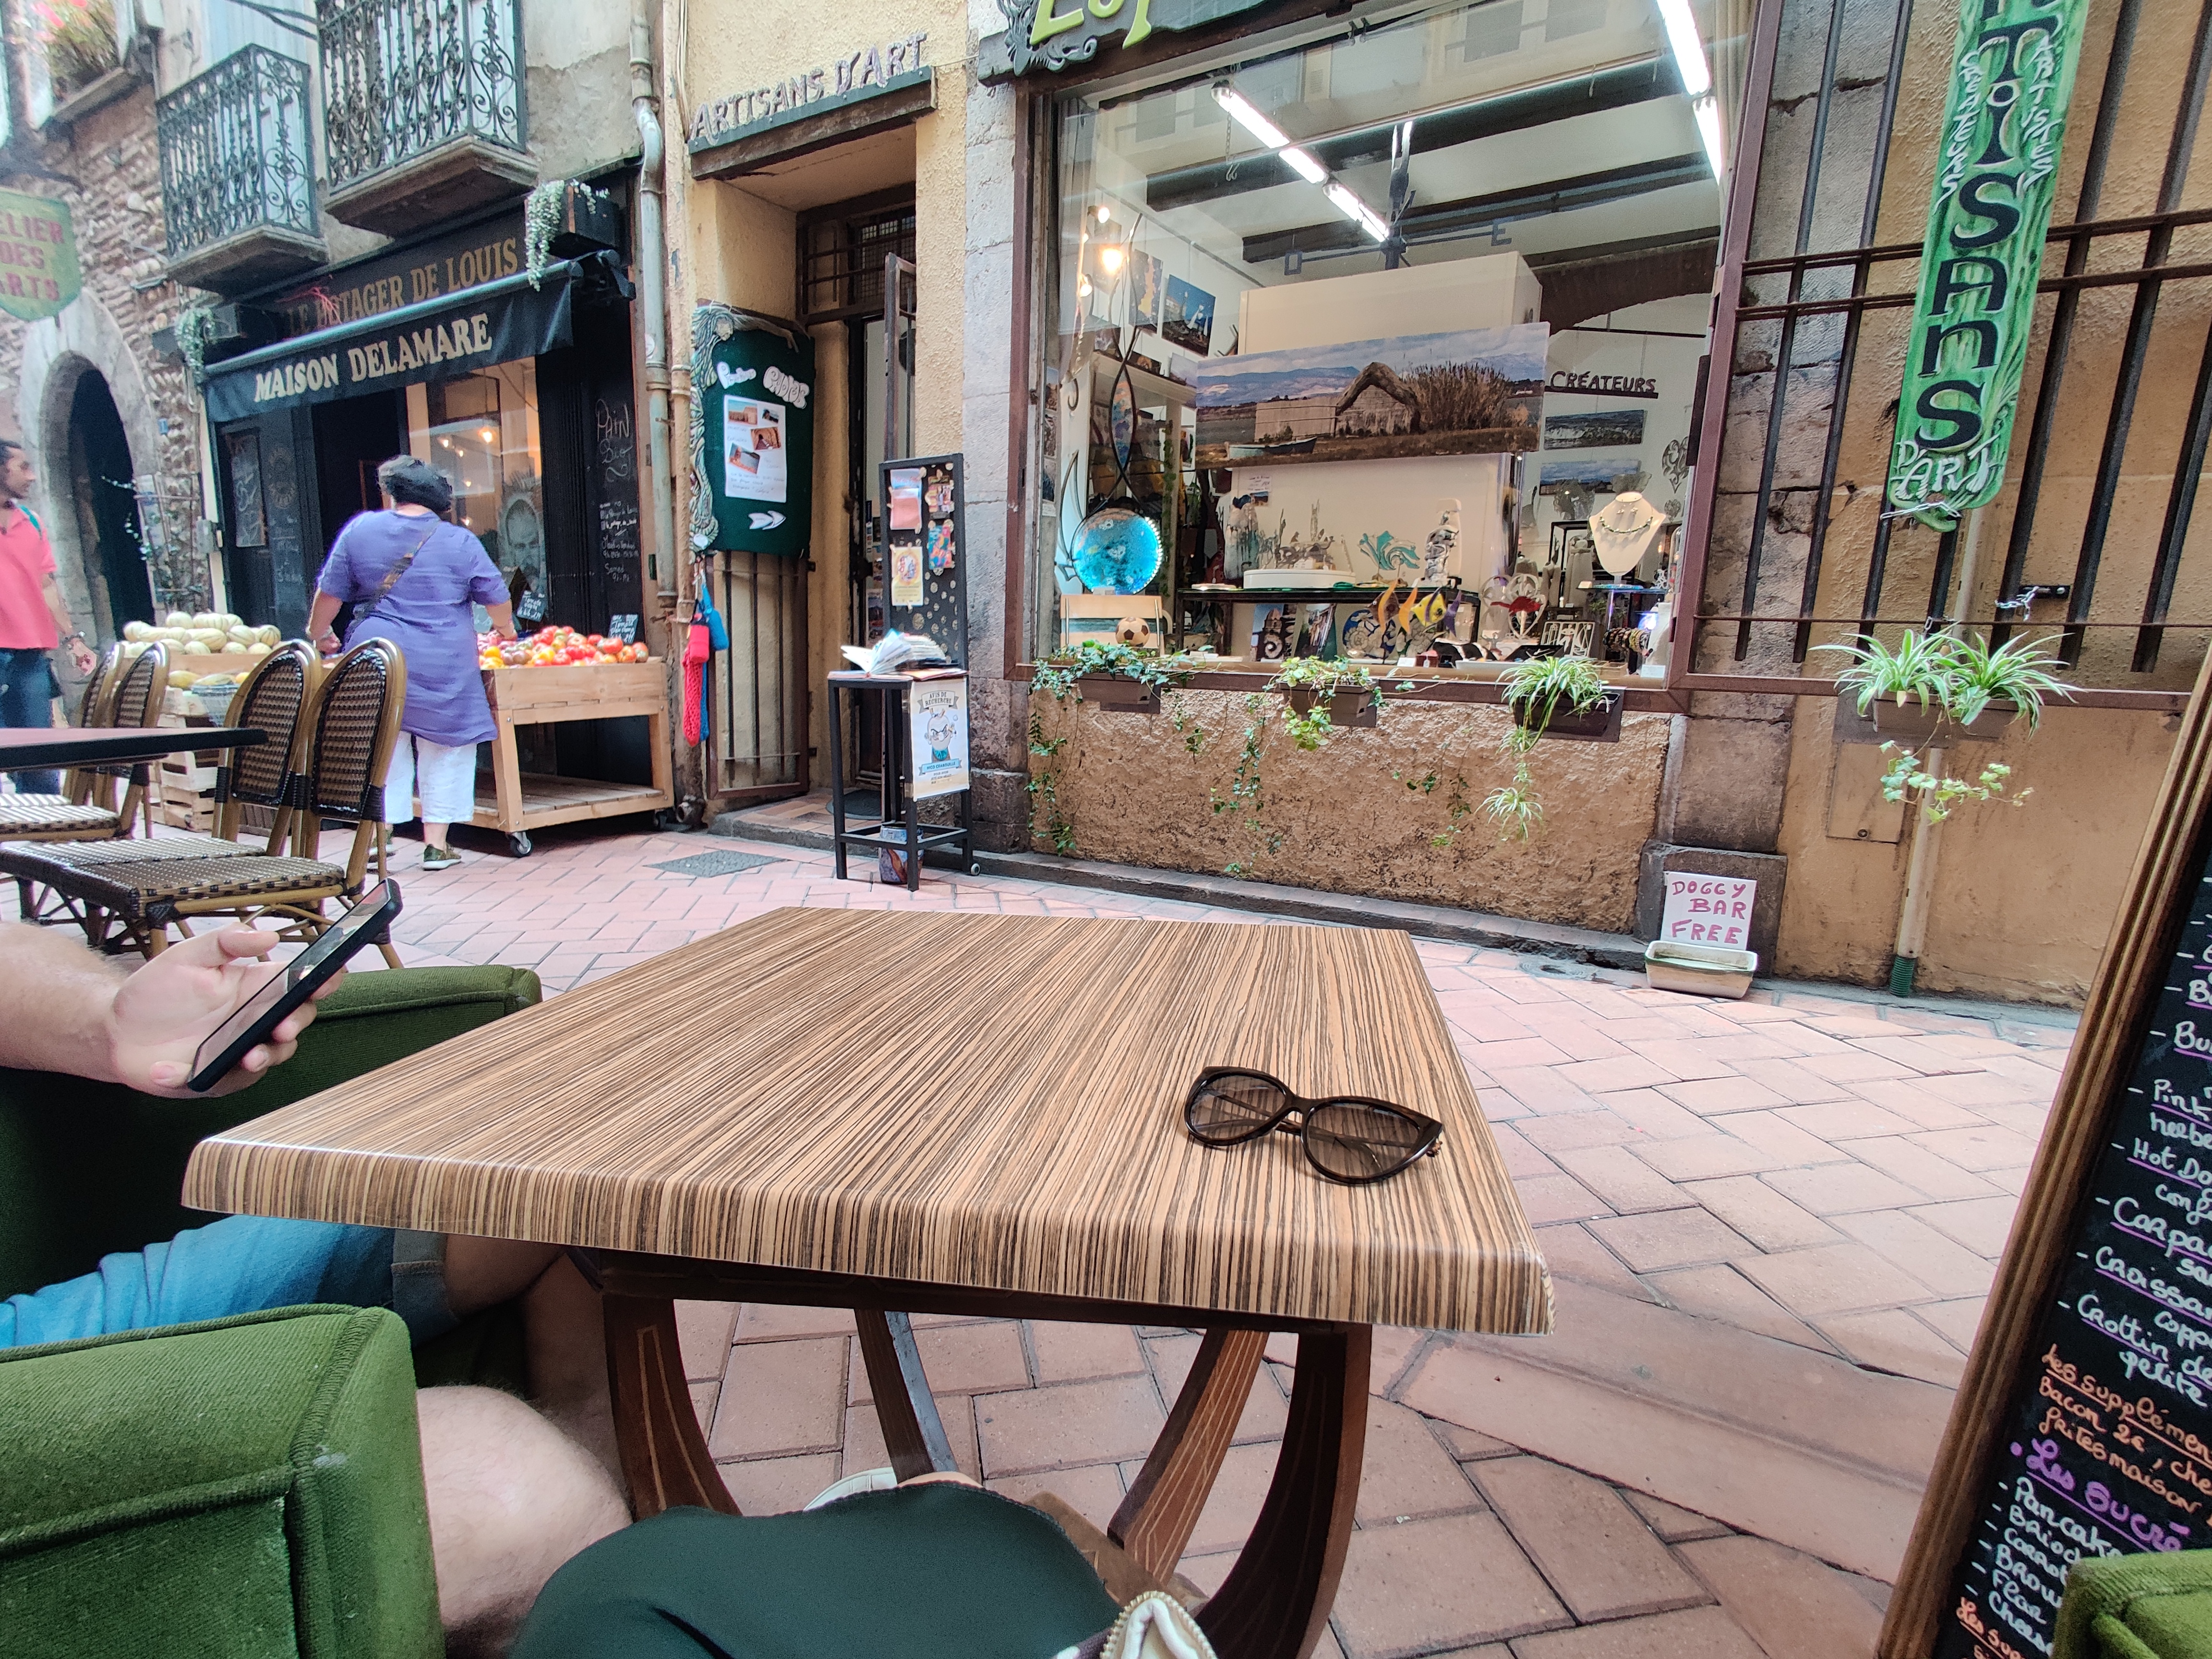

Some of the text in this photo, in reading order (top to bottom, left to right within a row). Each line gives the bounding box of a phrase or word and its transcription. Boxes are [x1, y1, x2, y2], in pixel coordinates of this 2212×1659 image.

[689, 32, 928, 147] ARTISANS D'ART
[410, 262, 438, 303] DE
[446, 237, 518, 294] LOUIS
[255, 313, 493, 402] MAISON DELAMARE
[1550, 371, 1657, 394] CRÉATEURS
[925, 698, 951, 706] RECHERCHE
[1671, 880, 1746, 899] DOGGY
[1688, 898, 1747, 920] BAR
[1671, 919, 1743, 944] FREE
[2154, 1079, 2212, 1121] Pink
[2132, 1137, 2177, 1170] Hot
[1992, 1569, 2047, 1625] Flan
